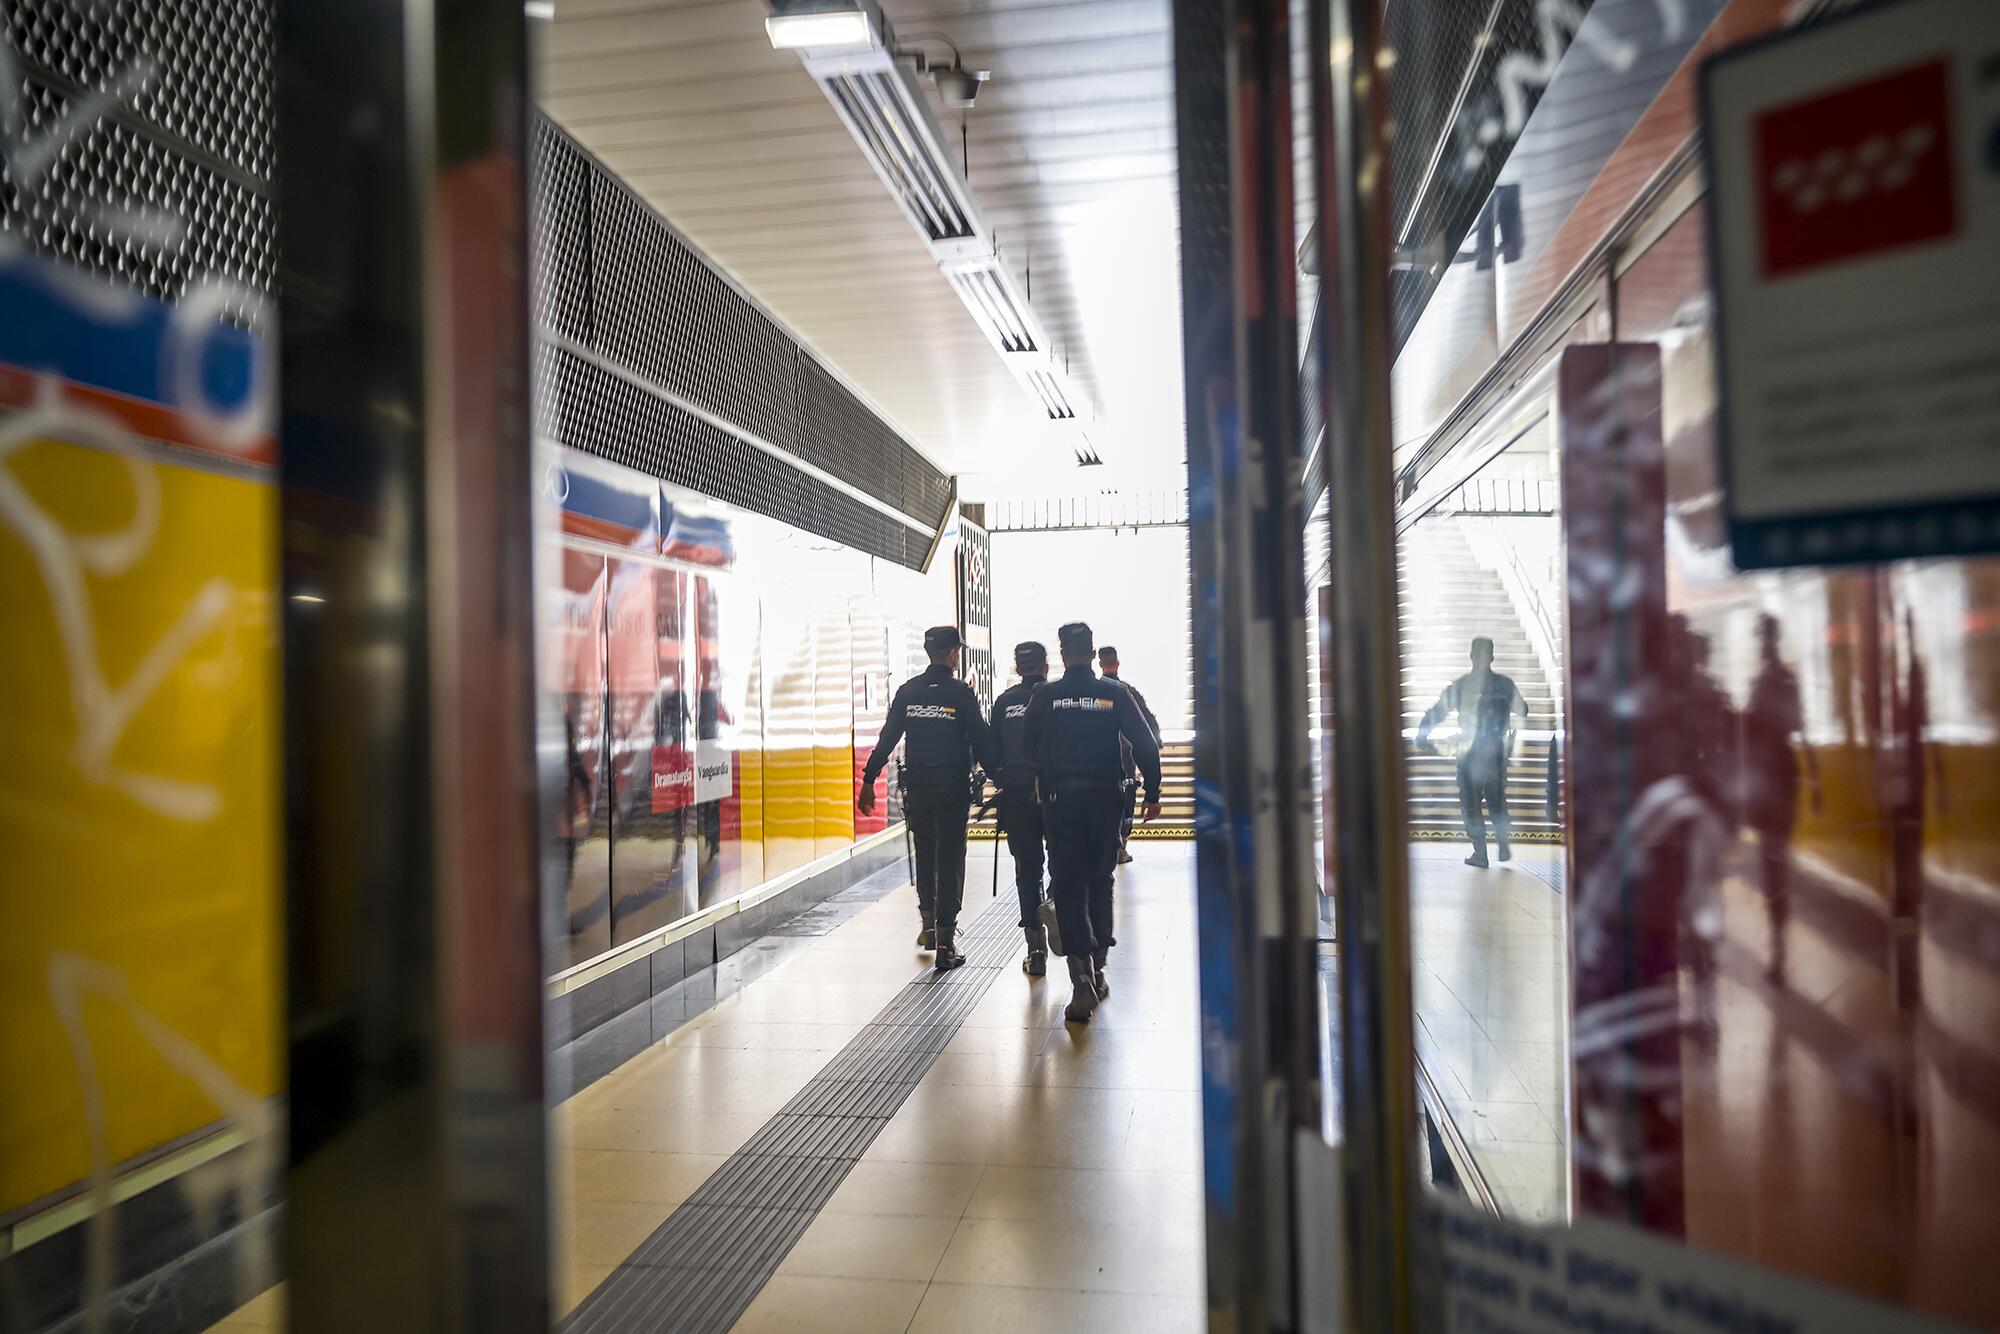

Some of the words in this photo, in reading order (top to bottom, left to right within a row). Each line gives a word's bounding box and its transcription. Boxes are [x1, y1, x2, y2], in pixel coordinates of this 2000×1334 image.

[906, 704, 944, 712] POLICIA
[1053, 697, 1100, 710] POLICIA
[906, 711, 956, 719] NACIONAL
[697, 761, 729, 781] Vanguardia
